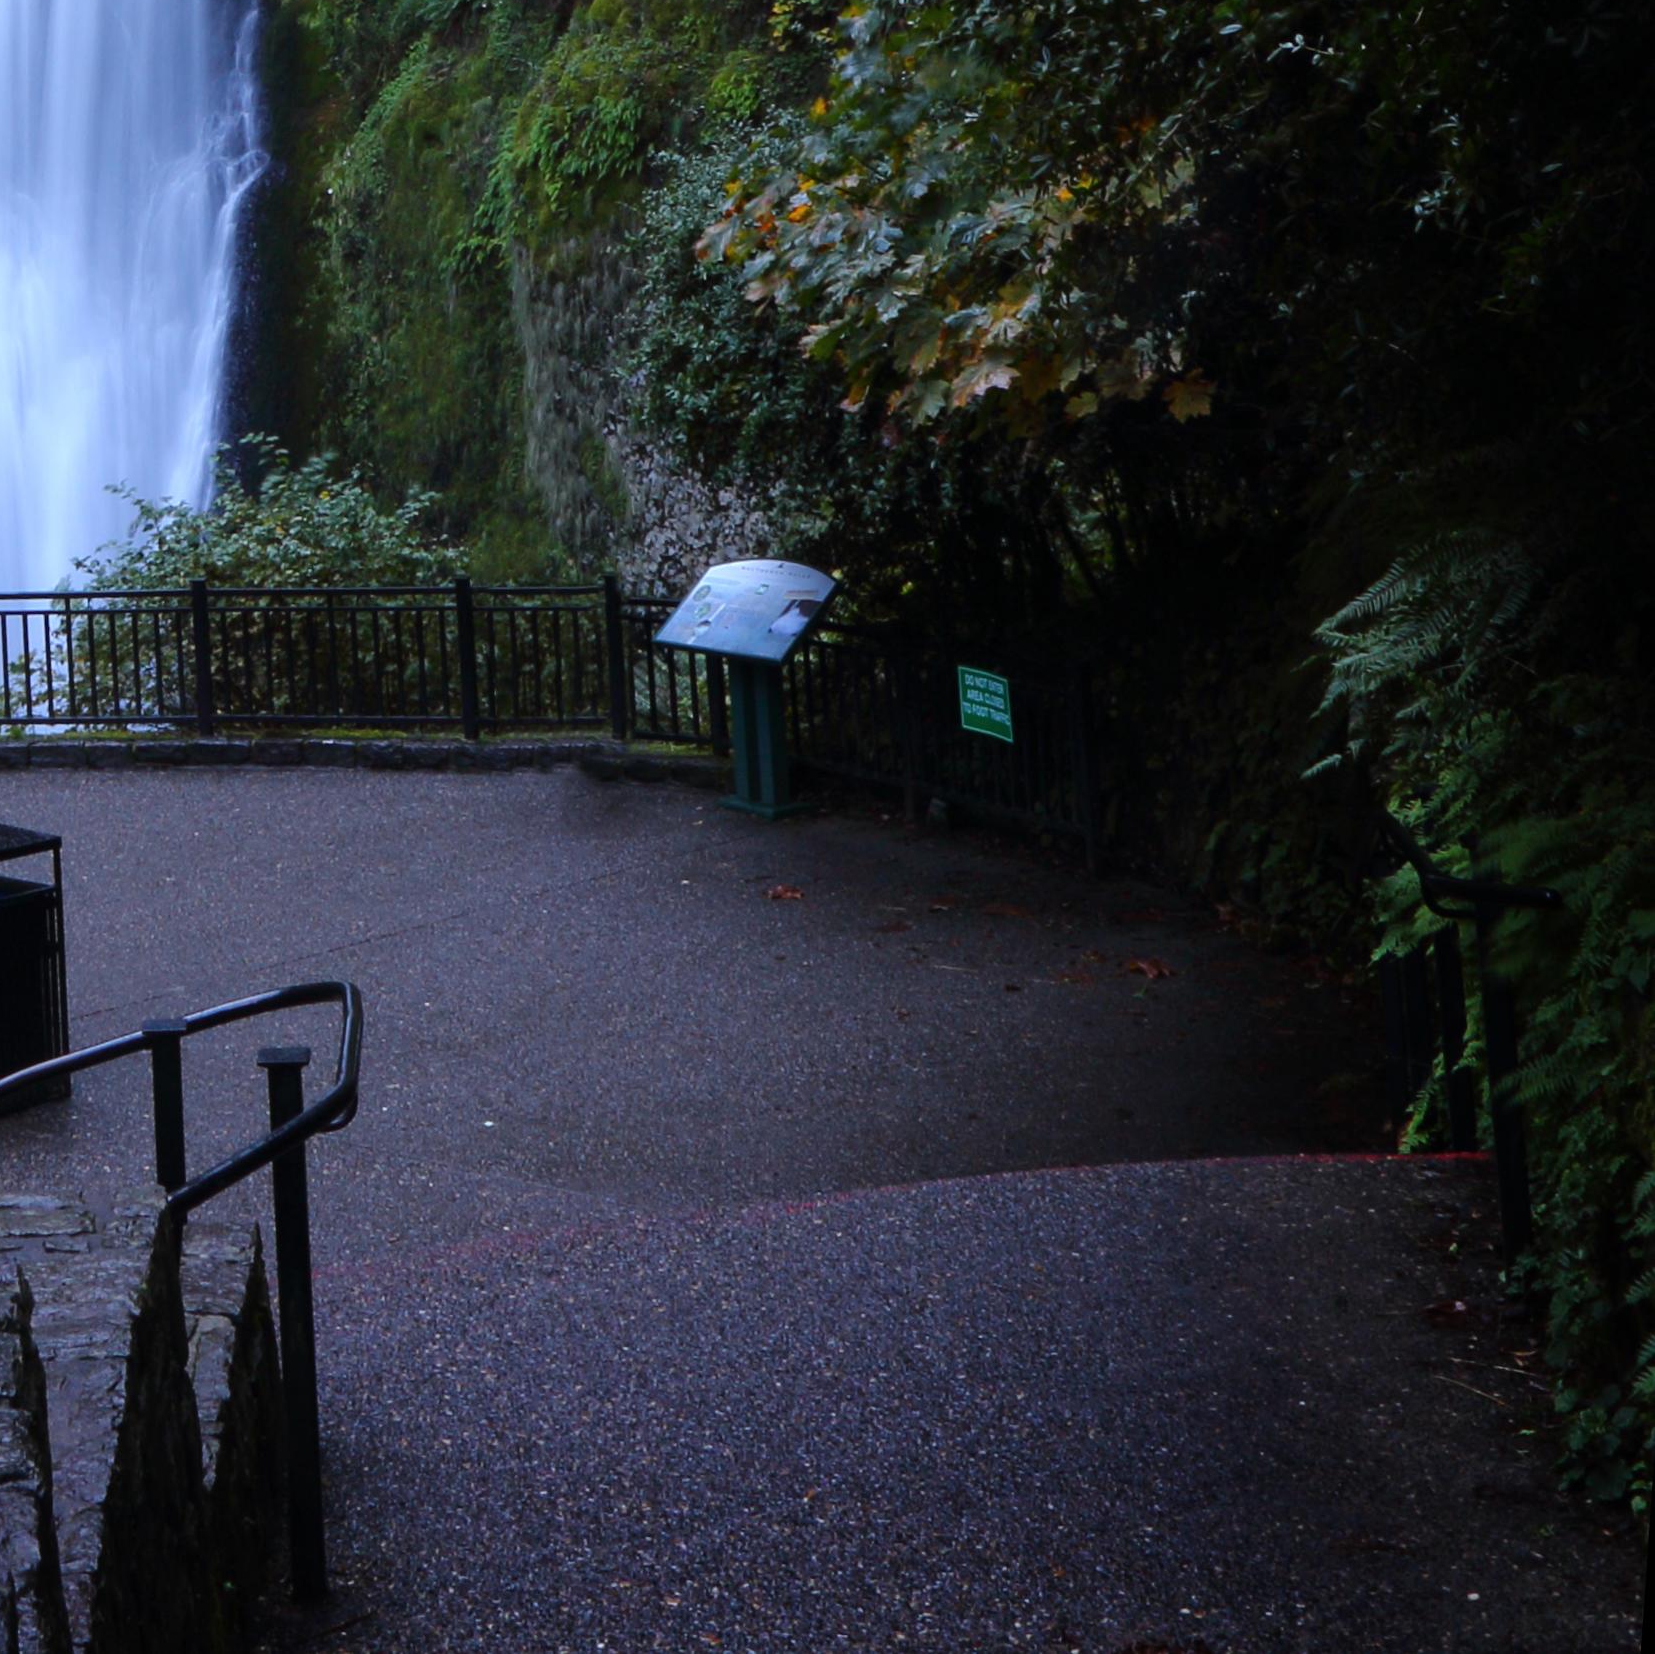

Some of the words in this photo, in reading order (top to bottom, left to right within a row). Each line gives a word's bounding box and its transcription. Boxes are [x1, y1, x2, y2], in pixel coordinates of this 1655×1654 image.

[964, 673, 974, 686] DO
[975, 676, 987, 689] NOT
[988, 680, 1004, 695] ENTER
[967, 689, 983, 701] AREA
[984, 693, 1005, 709] CLOSED
[962, 701, 971, 714] TO
[972, 703, 988, 717] FOOT
[989, 708, 1011, 726] TRAFFIC
